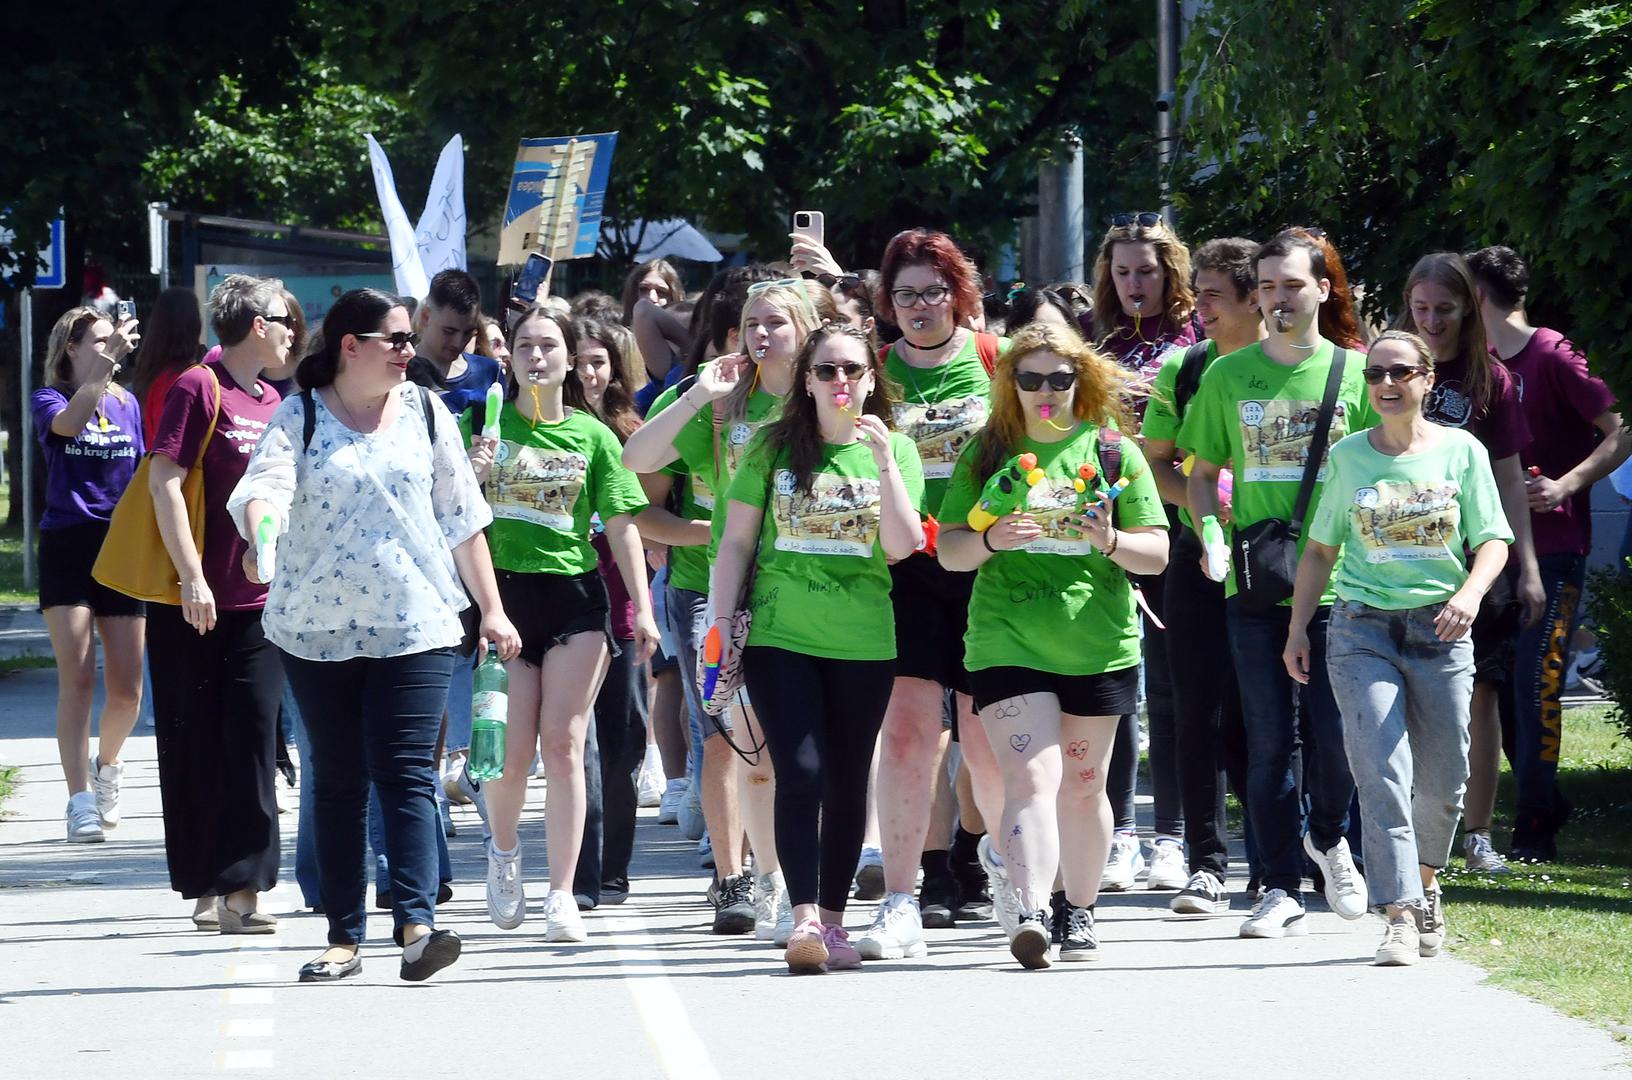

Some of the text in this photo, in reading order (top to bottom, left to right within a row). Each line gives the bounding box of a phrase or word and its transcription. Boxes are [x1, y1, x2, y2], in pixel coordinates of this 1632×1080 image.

[111, 434, 132, 443] ovo
[65, 444, 82, 456] bio
[84, 446, 110, 459] krug
[1242, 540, 1252, 590] Champion
